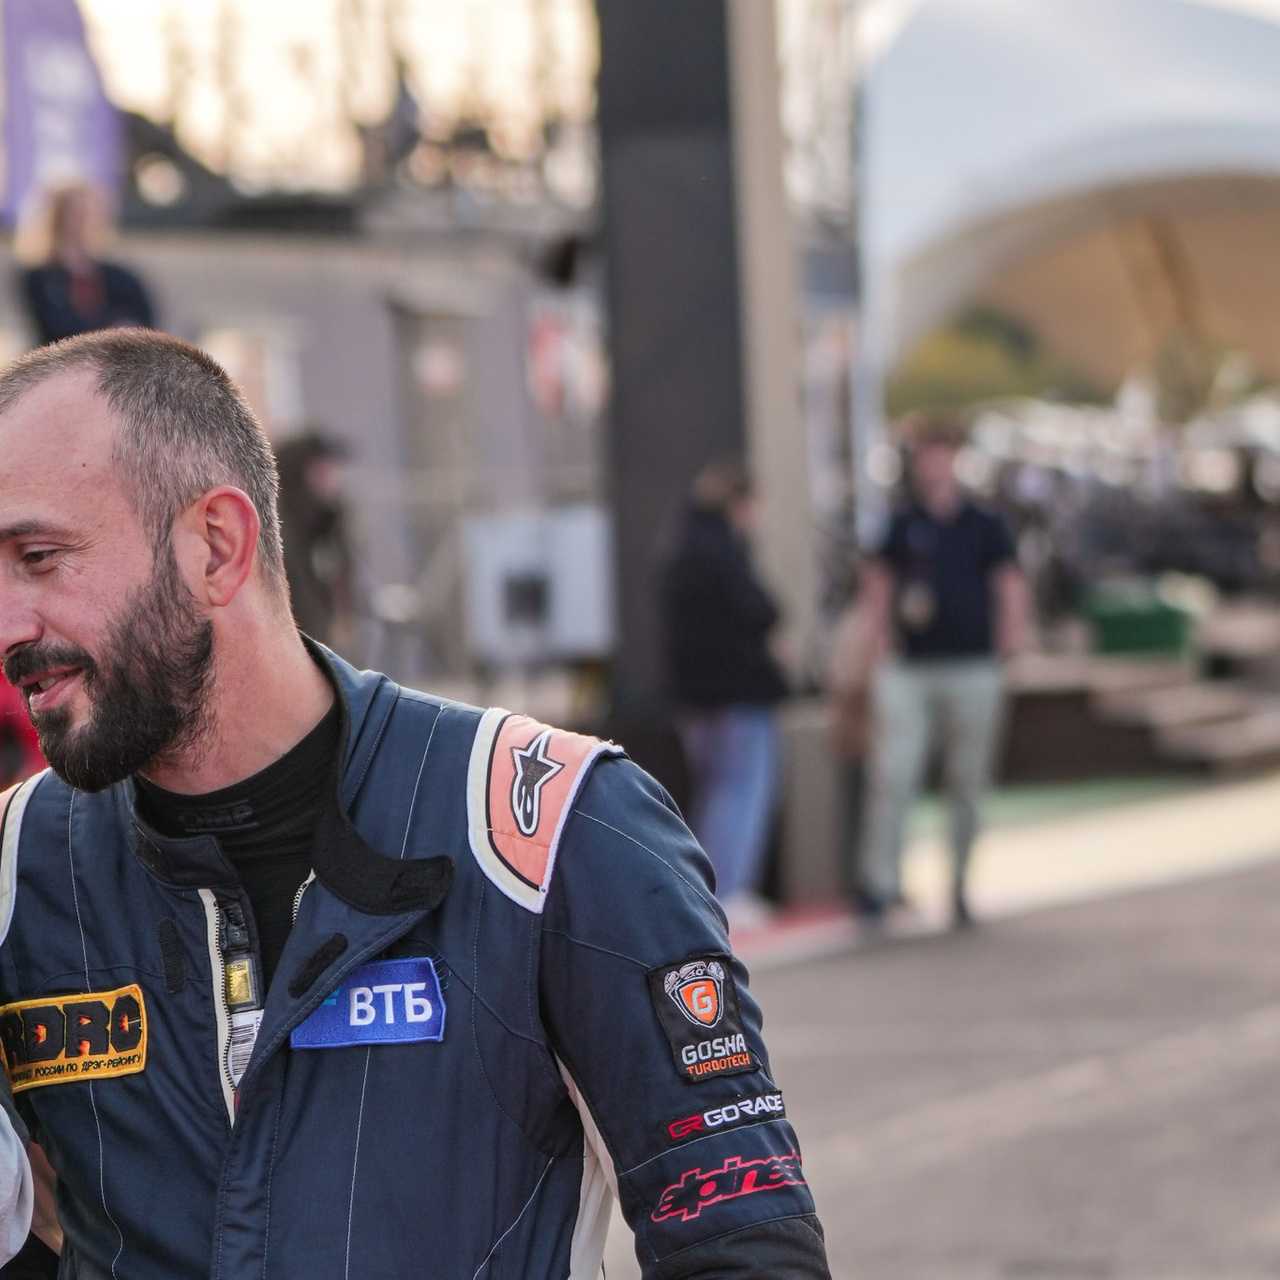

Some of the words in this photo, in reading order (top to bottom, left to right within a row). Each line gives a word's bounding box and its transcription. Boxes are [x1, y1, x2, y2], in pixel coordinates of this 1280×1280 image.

[349, 982, 433, 1027] ВТБ
[691, 985, 713, 1015] G
[681, 1033, 747, 1066] GOSHA
[686, 1053, 751, 1076] TURBOTECH
[703, 1094, 784, 1127] GORACE
